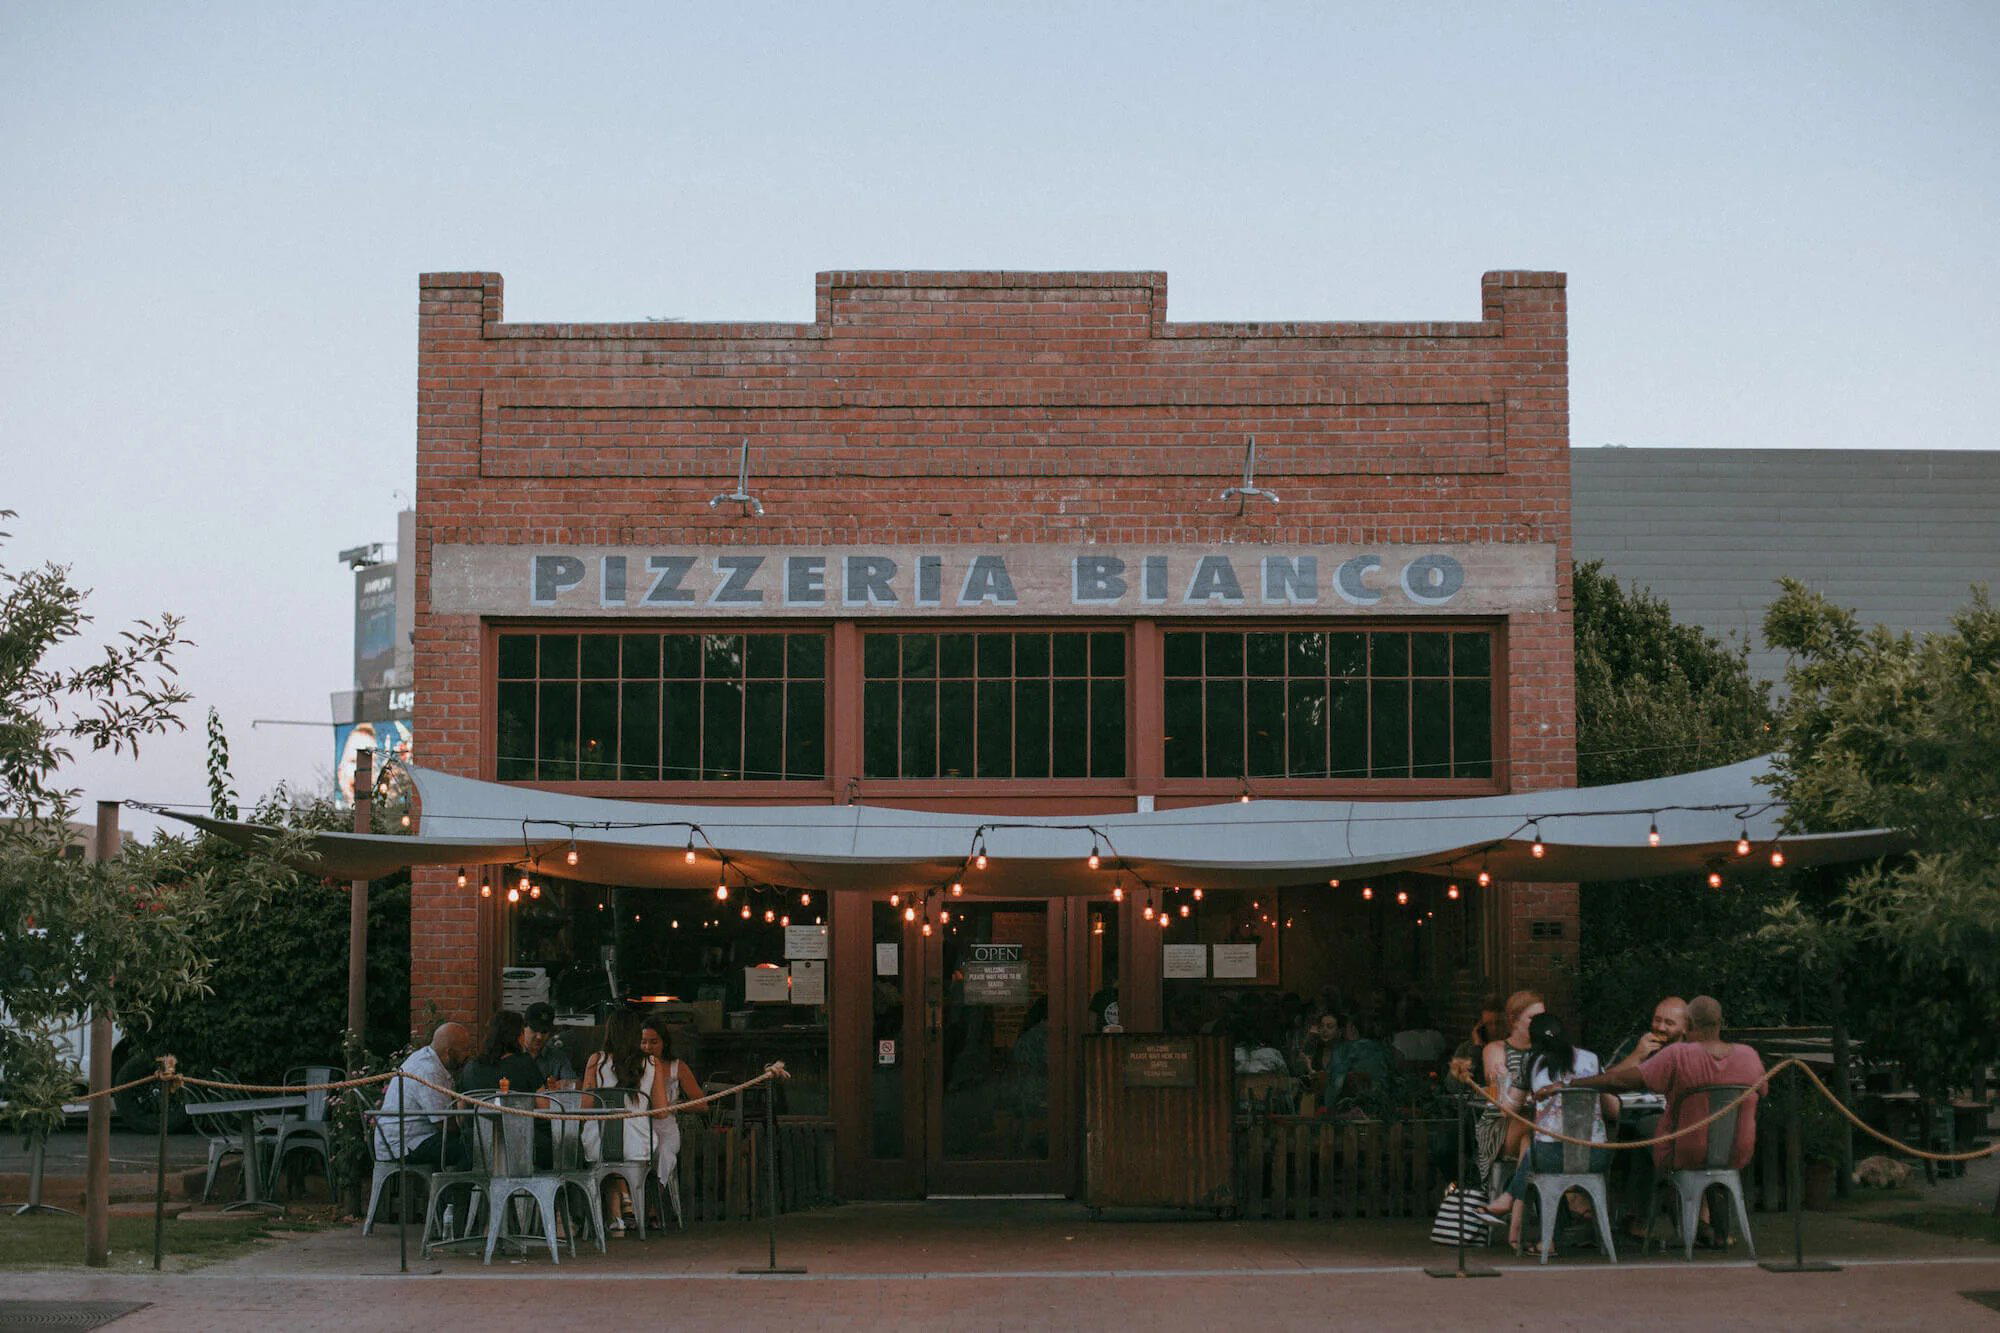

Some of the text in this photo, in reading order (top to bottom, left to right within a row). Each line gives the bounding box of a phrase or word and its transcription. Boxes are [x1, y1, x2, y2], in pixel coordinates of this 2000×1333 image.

[531, 553, 1465, 608] PIZZERIA BIANCO
[975, 947, 1018, 961] OPEN
